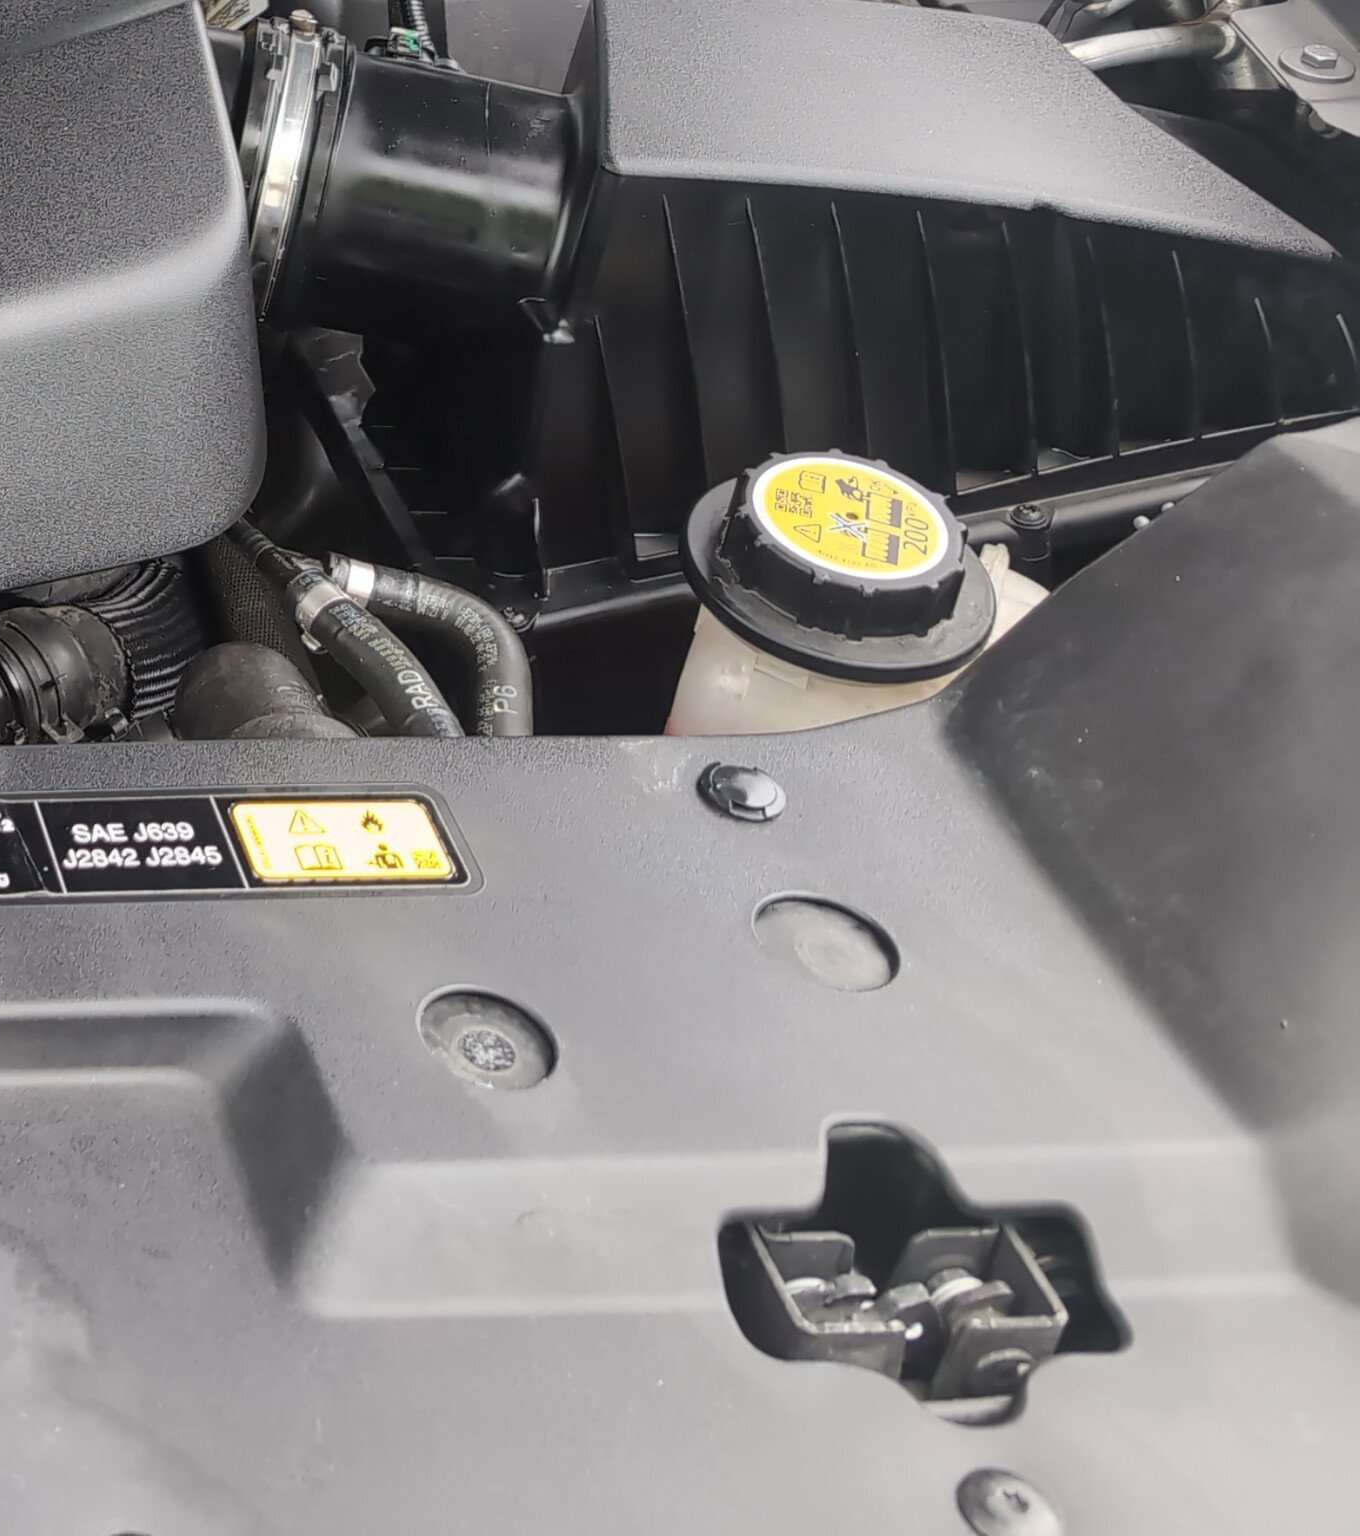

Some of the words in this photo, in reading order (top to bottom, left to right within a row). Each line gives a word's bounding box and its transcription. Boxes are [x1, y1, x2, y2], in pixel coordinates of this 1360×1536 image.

[902, 516, 930, 556] 200
[397, 669, 439, 711] RAD
[493, 684, 518, 715] P6
[71, 822, 128, 844] SAE
[135, 820, 195, 842] J639
[62, 846, 141, 870] J2842
[144, 843, 223, 868] J2845
